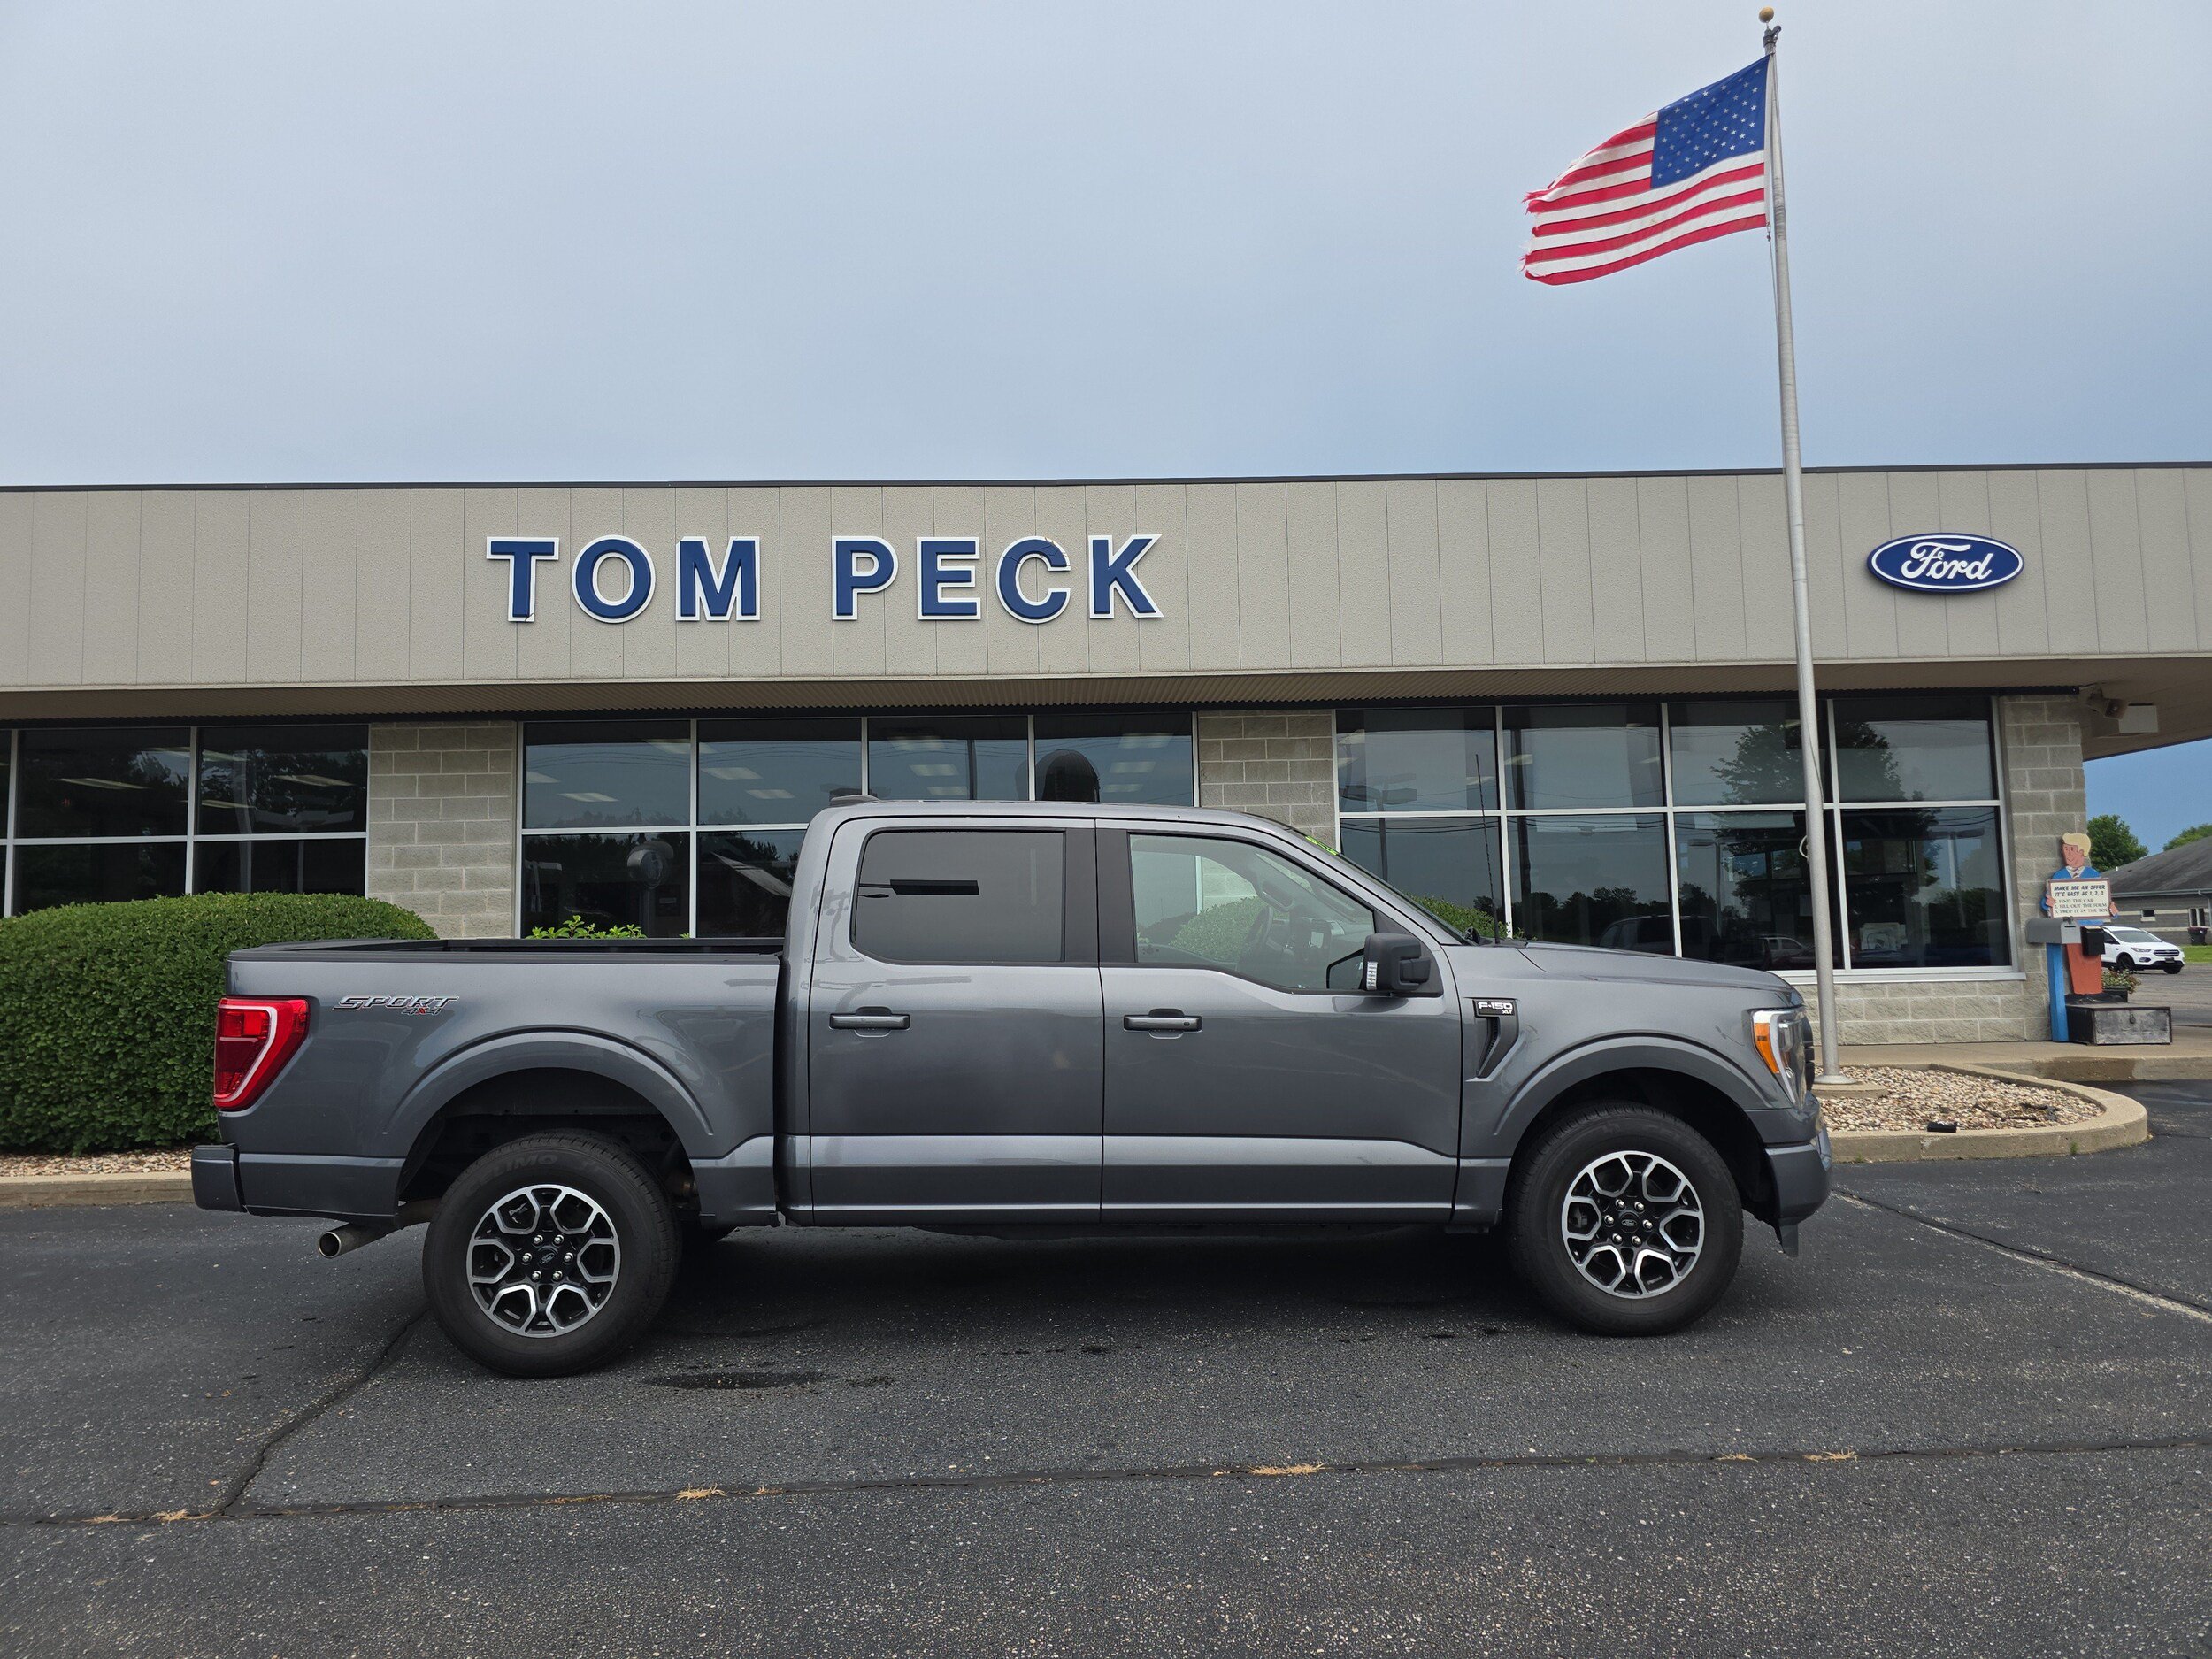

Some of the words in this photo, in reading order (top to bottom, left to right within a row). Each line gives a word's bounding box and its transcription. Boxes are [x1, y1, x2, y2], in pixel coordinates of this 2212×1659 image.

[486, 534, 761, 623] TOM
[832, 534, 1164, 624] PECK
[1901, 541, 1993, 580] Ford
[333, 995, 459, 1010] SPORT
